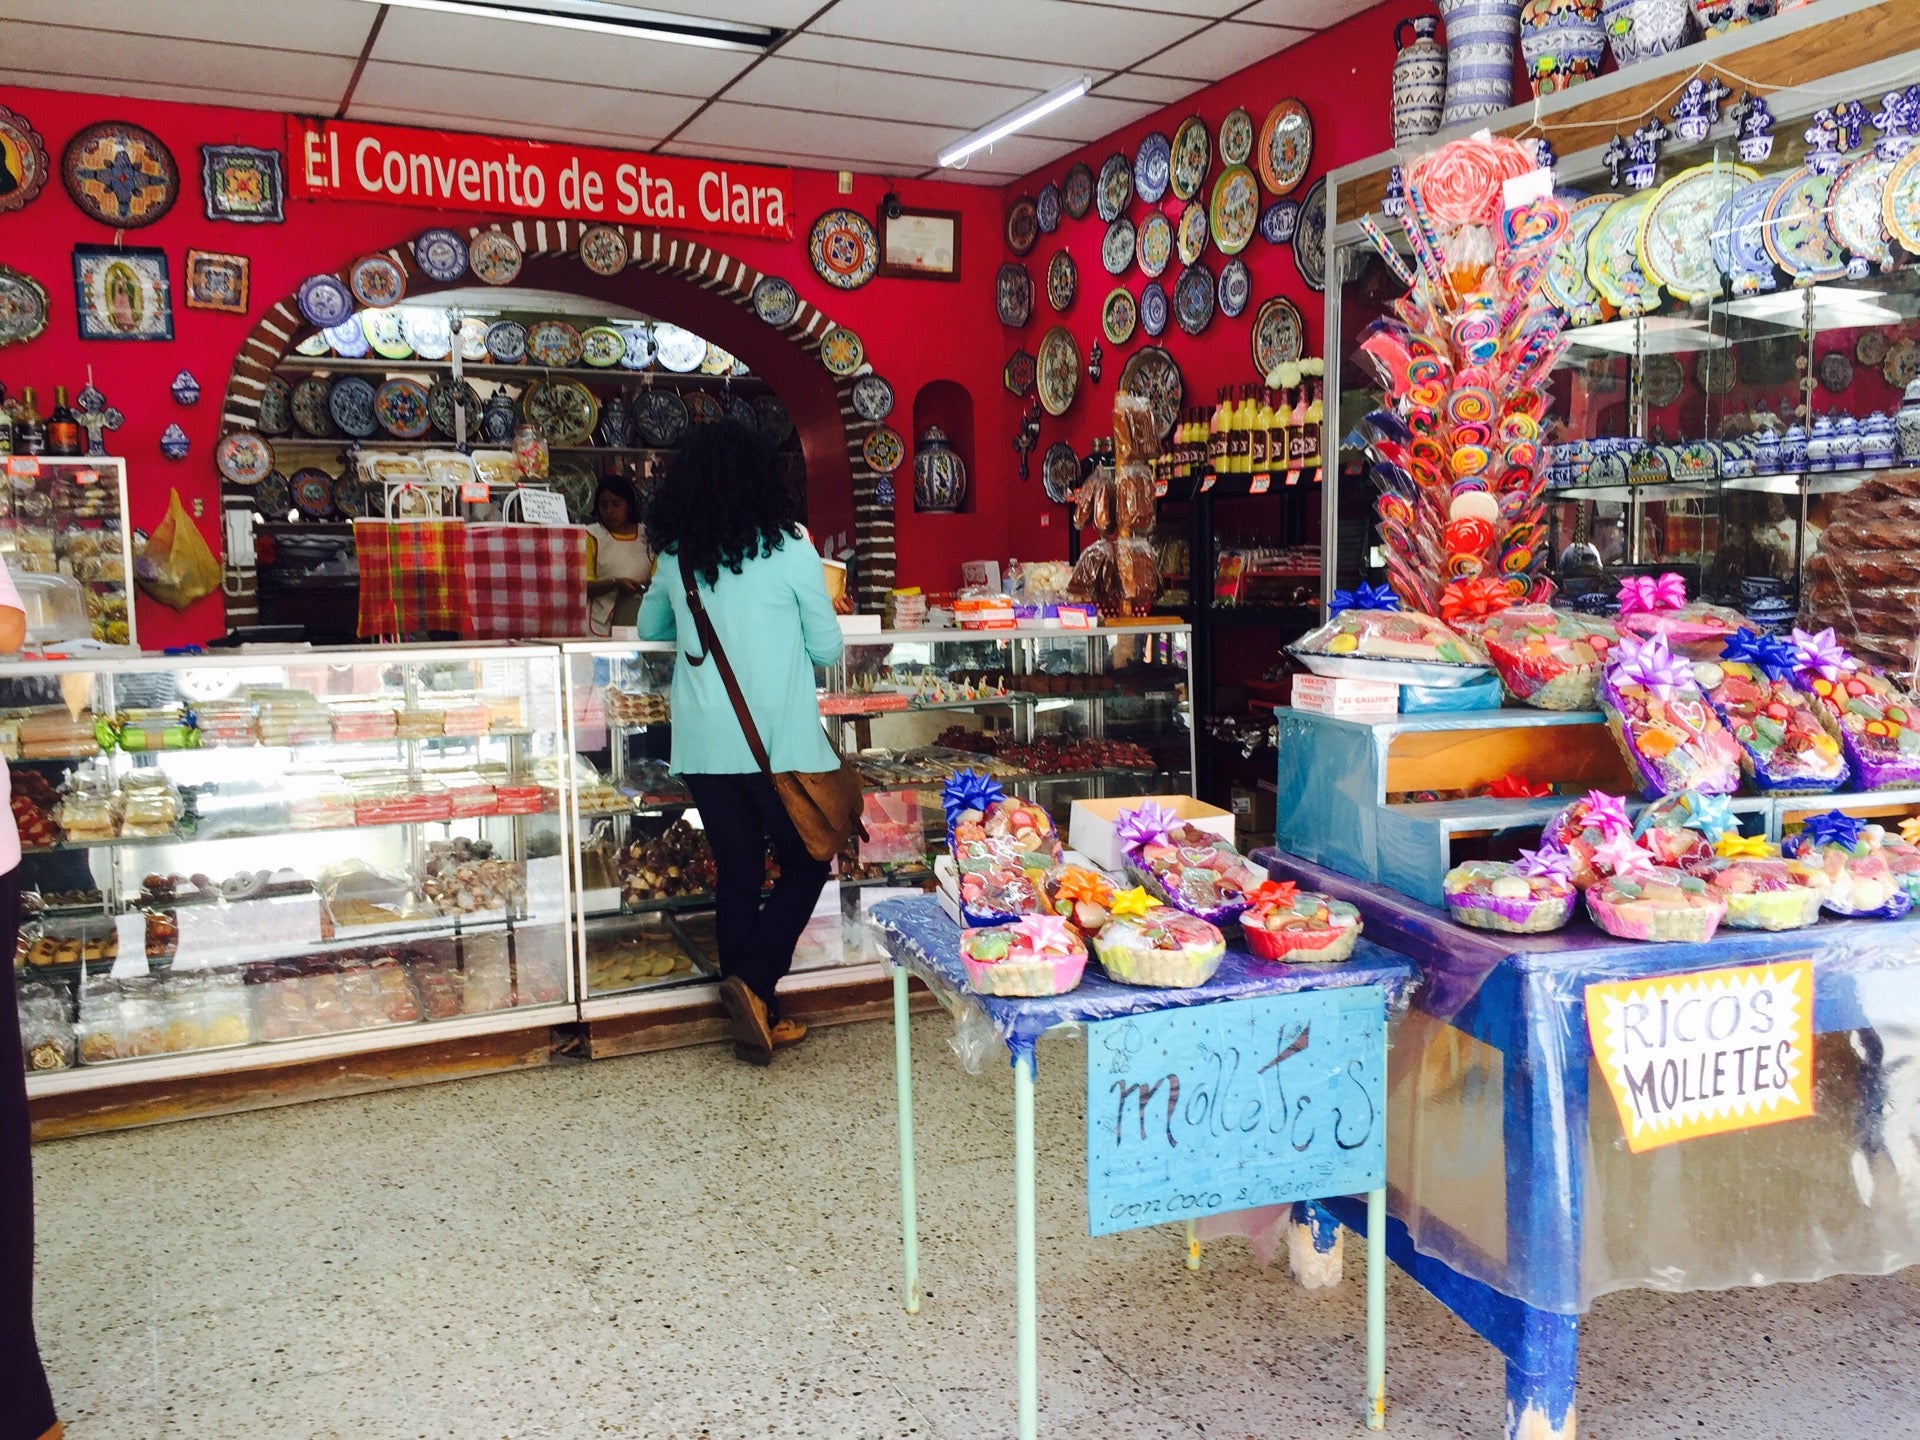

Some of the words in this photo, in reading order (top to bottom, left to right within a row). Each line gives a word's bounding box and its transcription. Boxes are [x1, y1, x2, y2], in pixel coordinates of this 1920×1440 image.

[304, 131, 339, 188] El
[355, 136, 546, 208] Convento
[558, 158, 604, 211] de
[615, 163, 686, 219] Sta.
[698, 171, 785, 227] Clara
[1623, 989, 1774, 1054] RICOS
[1623, 1040, 1791, 1119] MOLLETES
